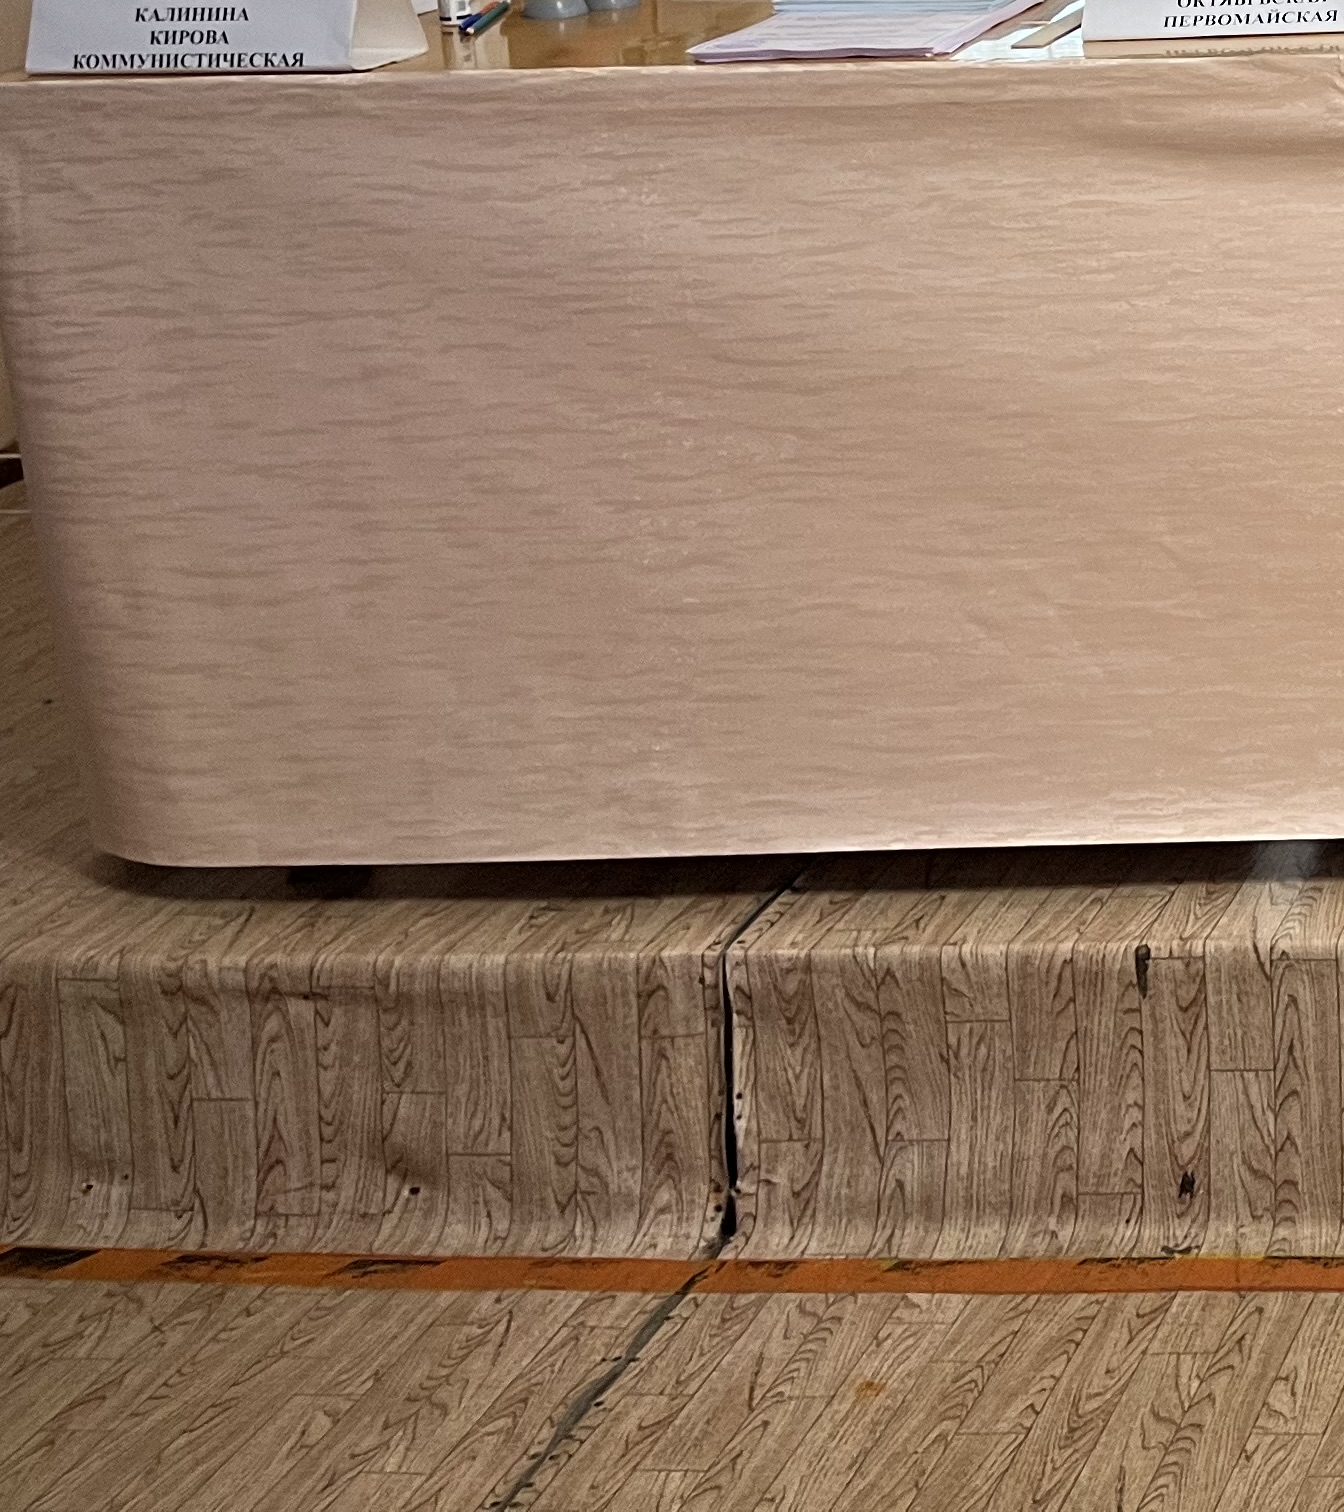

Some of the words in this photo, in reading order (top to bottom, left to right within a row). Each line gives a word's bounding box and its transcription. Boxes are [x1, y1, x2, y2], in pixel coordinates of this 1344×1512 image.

[134, 7, 249, 23] КАЛИНИНА
[1163, 9, 1338, 28] ПЕРВОМАЙСКАЯ
[149, 29, 230, 46] КИРОВА
[73, 52, 305, 70] КОММУНИСТИЧЕСКАЯ
